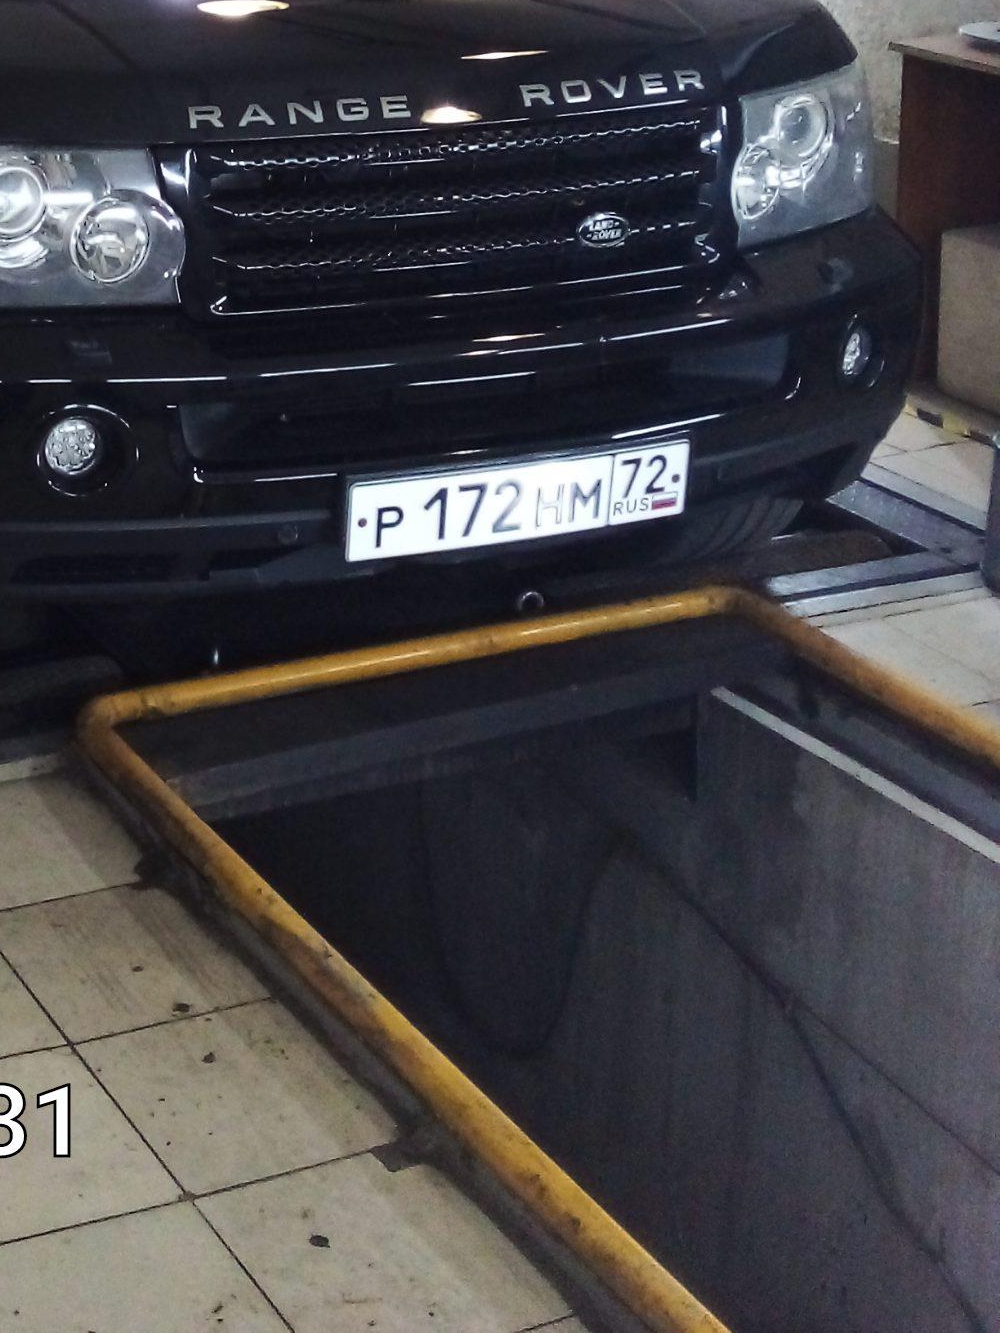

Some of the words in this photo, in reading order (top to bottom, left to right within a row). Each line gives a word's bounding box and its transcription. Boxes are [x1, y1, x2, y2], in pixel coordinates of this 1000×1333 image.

[188, 95, 411, 129] RANGE
[519, 70, 705, 107] ROVER
[621, 454, 668, 499] 72
[613, 497, 649, 516] RUS
